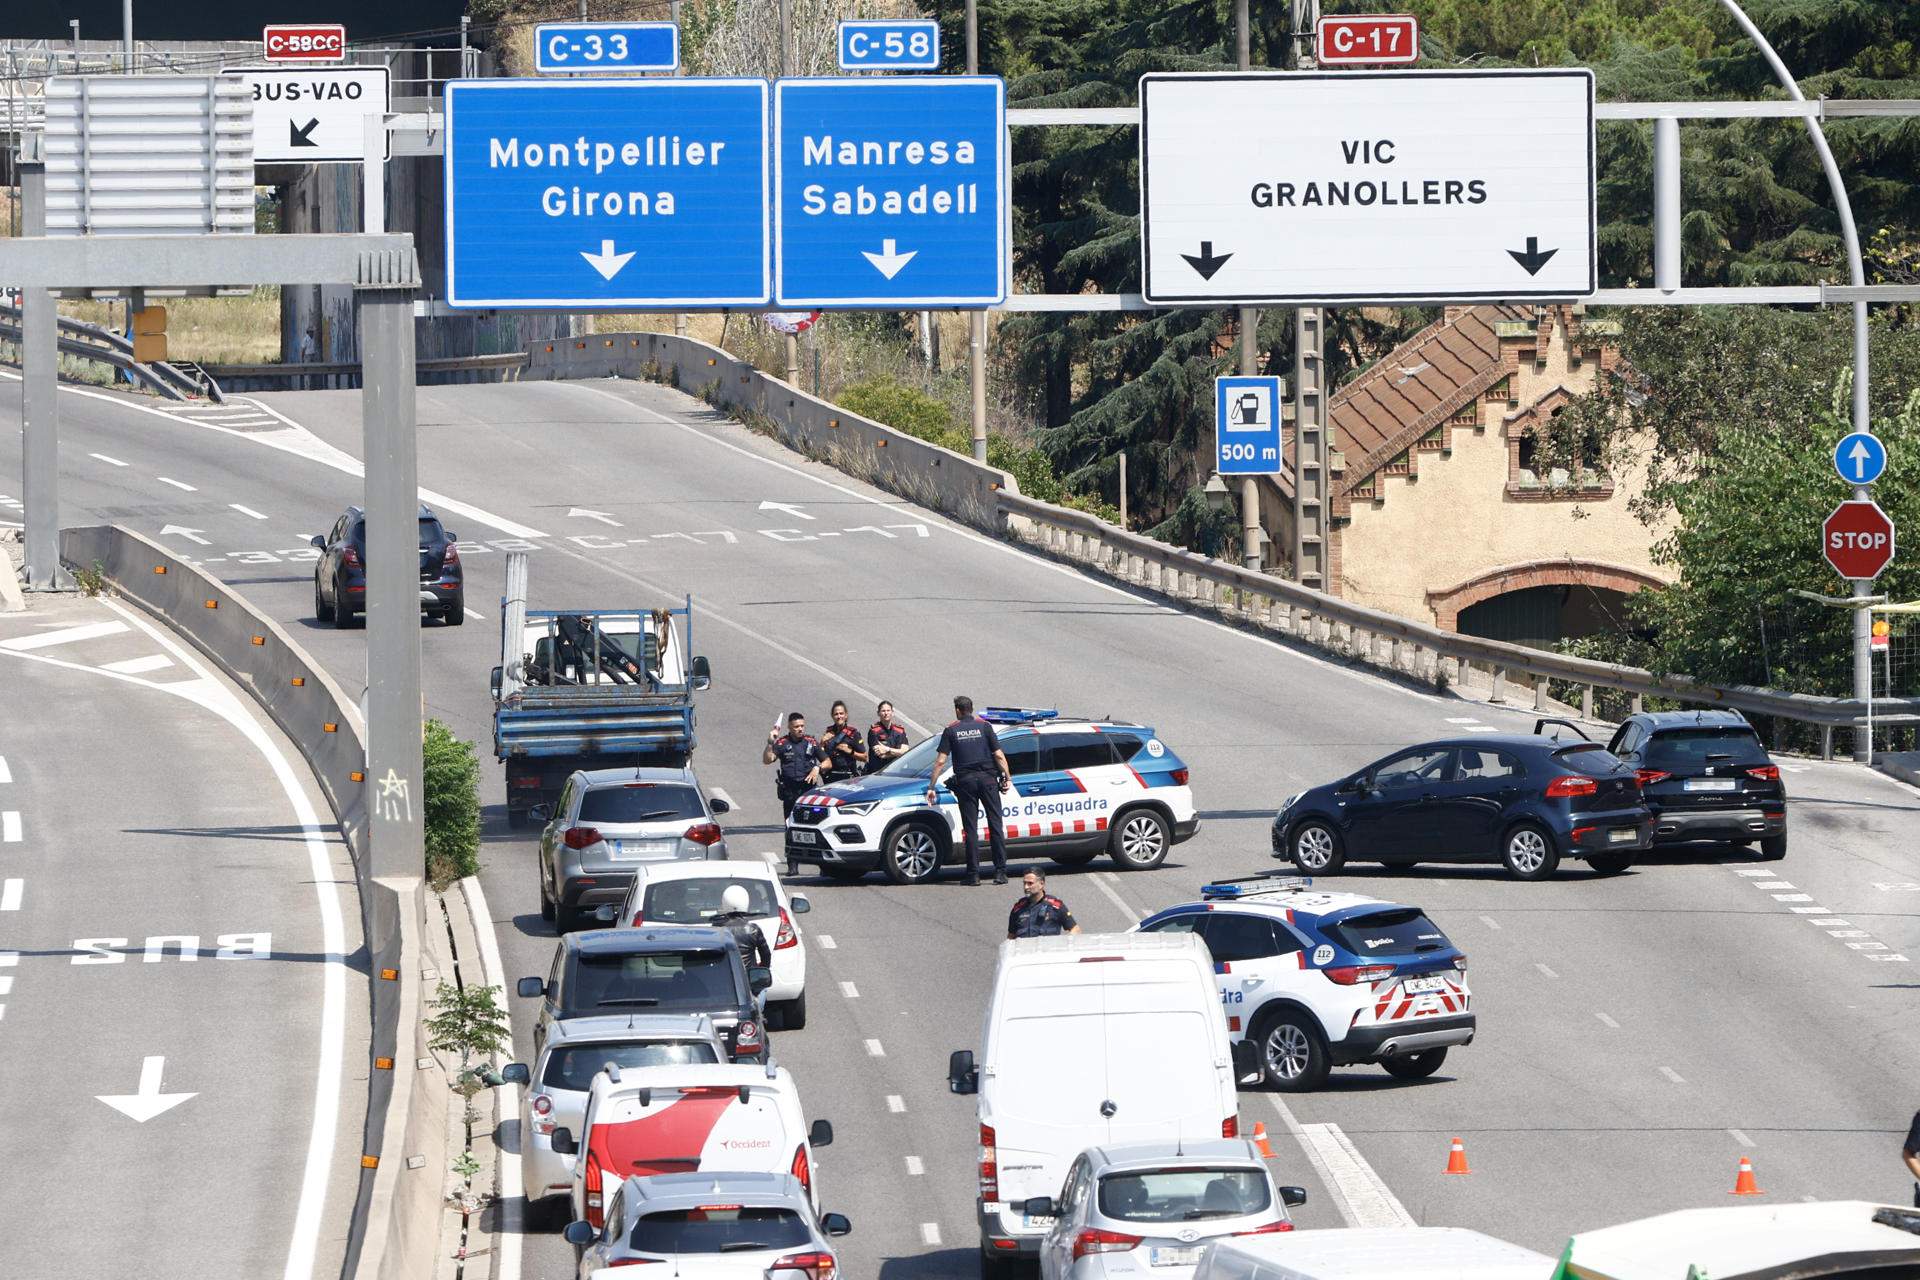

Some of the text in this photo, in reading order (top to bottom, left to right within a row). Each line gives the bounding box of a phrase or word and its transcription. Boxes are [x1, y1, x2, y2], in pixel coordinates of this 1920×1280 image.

[268, 34, 341, 53] C-58CC
[549, 35, 629, 59] C-33
[848, 32, 930, 58] C-58
[1333, 26, 1402, 53] C-17
[253, 81, 363, 101] BUS-VAO
[489, 136, 726, 173] Montpellier
[803, 135, 976, 166] Manresa
[1340, 139, 1396, 165] VIC
[541, 186, 676, 217] Girona
[802, 183, 978, 216] Sabadell
[1251, 179, 1488, 209] GRANOLLERS
[1221, 443, 1277, 461] 500 m
[1830, 531, 1887, 550] STOP
[70, 932, 272, 965] BUS
[1316, 949, 1332, 958] 112
[730, 1139, 771, 1149] Occident
